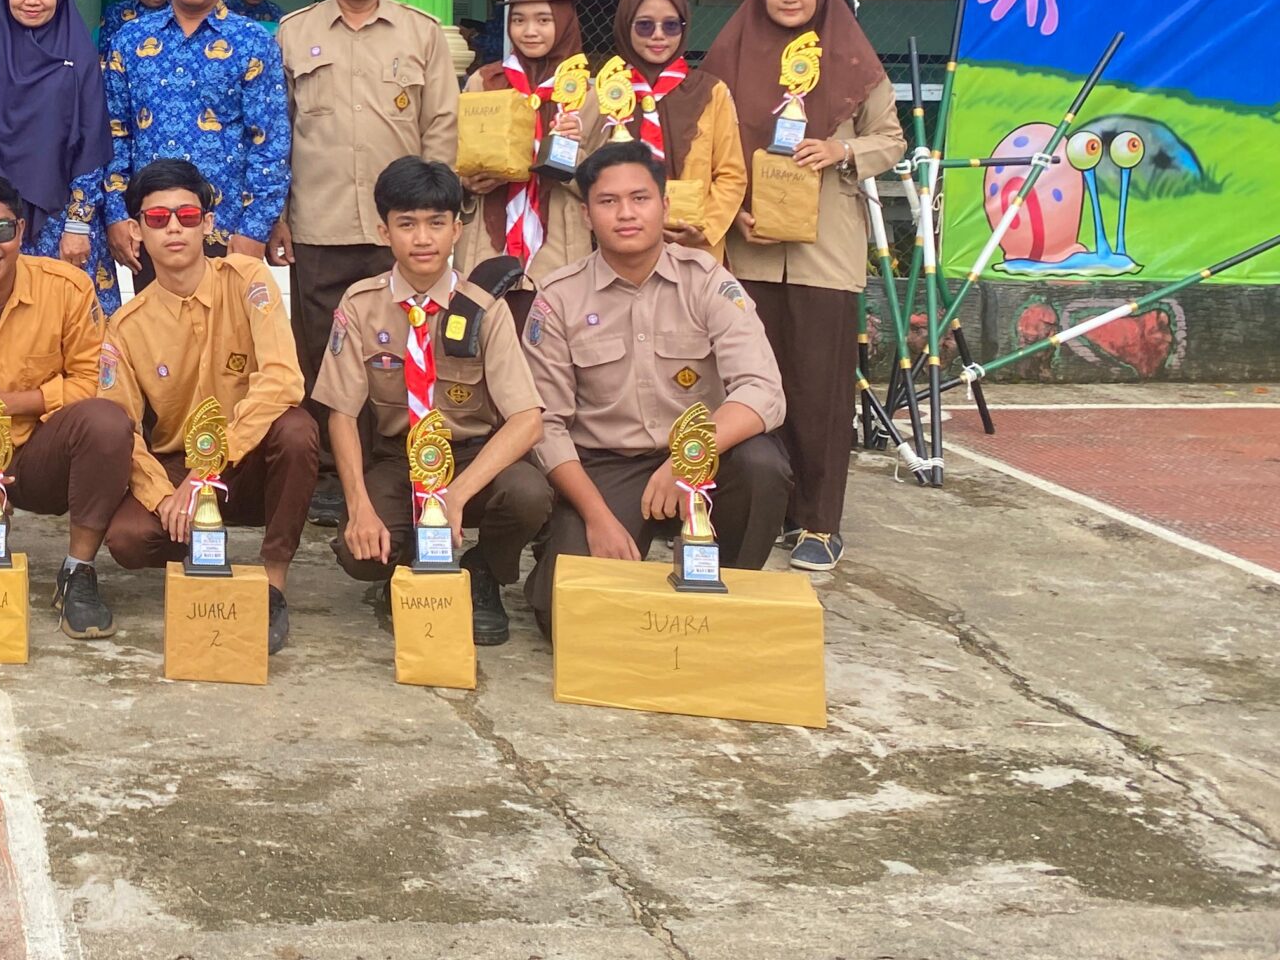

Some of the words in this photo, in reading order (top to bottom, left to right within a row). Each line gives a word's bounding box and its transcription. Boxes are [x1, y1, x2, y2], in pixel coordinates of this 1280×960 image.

[760, 167, 807, 183] HARAPAN
[777, 192, 788, 205] 2
[186, 602, 237, 620] JUARA
[400, 596, 453, 611] HARAPAN
[424, 622, 434, 638] 2
[639, 610, 710, 636] JUARA
[672, 645, 680, 671] 1
